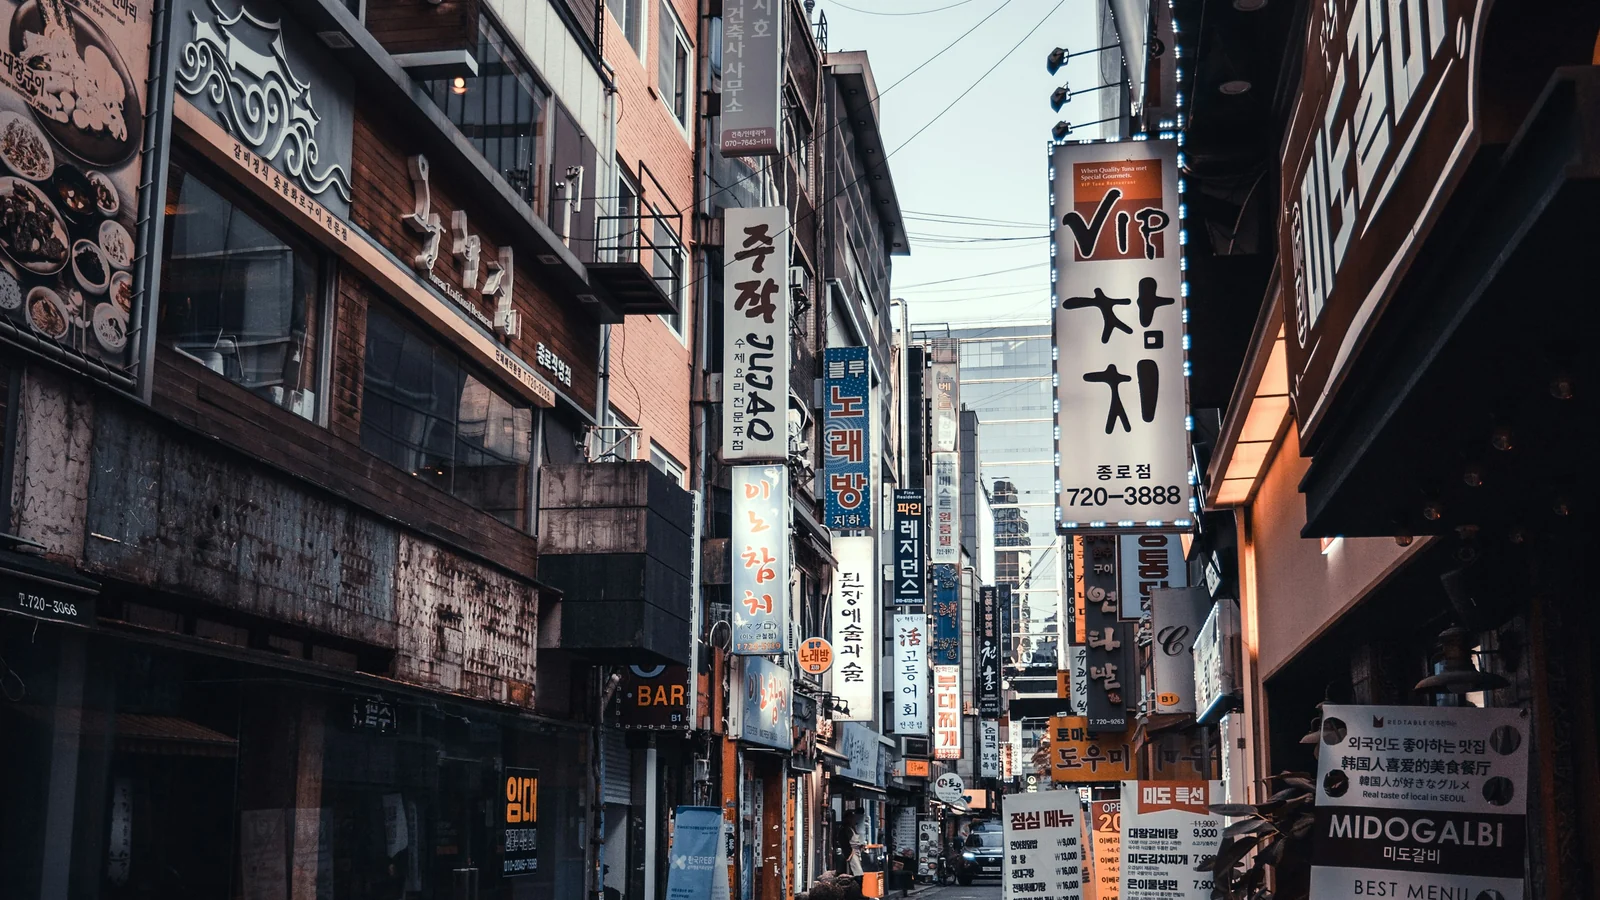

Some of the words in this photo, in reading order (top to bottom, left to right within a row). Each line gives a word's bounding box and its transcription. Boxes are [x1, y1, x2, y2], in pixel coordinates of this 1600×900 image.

[1099, 166, 1120, 174] Quality
[233, 143, 269, 181] 갈비정식
[326, 215, 348, 241] 전문점
[1062, 187, 1169, 260] VIP
[734, 223, 779, 323] 주작
[537, 342, 572, 388] 종로직영점
[1062, 277, 1175, 434] 참치
[829, 360, 864, 379] 블루
[829, 386, 867, 509] 노래방
[1096, 464, 1151, 480] 종로점
[1067, 485, 1181, 507] 720-3888
[897, 503, 921, 516] 파인
[834, 514, 861, 527] 지하
[900, 520, 919, 594] 레지던스
[1094, 563, 1113, 575] 구이
[18, 592, 77, 616] T.720-3066
[801, 649, 829, 662] 노래방
[638, 685, 685, 706] BAR
[1161, 695, 1174, 703] B1
[671, 714, 681, 722] B1
[937, 674, 957, 747] 부대찌개
[1096, 717, 1124, 725] 720-9263
[1348, 736, 1400, 751] 외국인도
[1402, 738, 1456, 754] 좋아하는
[1459, 739, 1486, 756] 맛집
[1055, 743, 1131, 773] 도우미
[1341, 755, 1491, 776] 韩国人喜爱的美食餐厅
[1359, 776, 1470, 791] 韓国人が好きなグルメ
[506, 776, 538, 823] 임대
[1143, 786, 1171, 805] 미도
[1175, 786, 1204, 805] 특선
[1362, 790, 1379, 799] Real
[1380, 792, 1400, 800] taste
[1401, 791, 1409, 800] of
[1410, 792, 1429, 801] local
[1430, 793, 1437, 801] in
[1439, 794, 1466, 803] SEOUL
[1010, 811, 1040, 831] 점심
[1043, 809, 1075, 828] 메뉴
[1128, 828, 1178, 839] 대왕갈비탕
[1193, 828, 1218, 838] 9,900
[1329, 814, 1503, 848] MIDOGALBI
[1128, 853, 1188, 865] 미도김치찌개
[1383, 846, 1440, 864] 미도갈비
[1354, 880, 1397, 897] BEST
[1407, 884, 1469, 900] MENU
